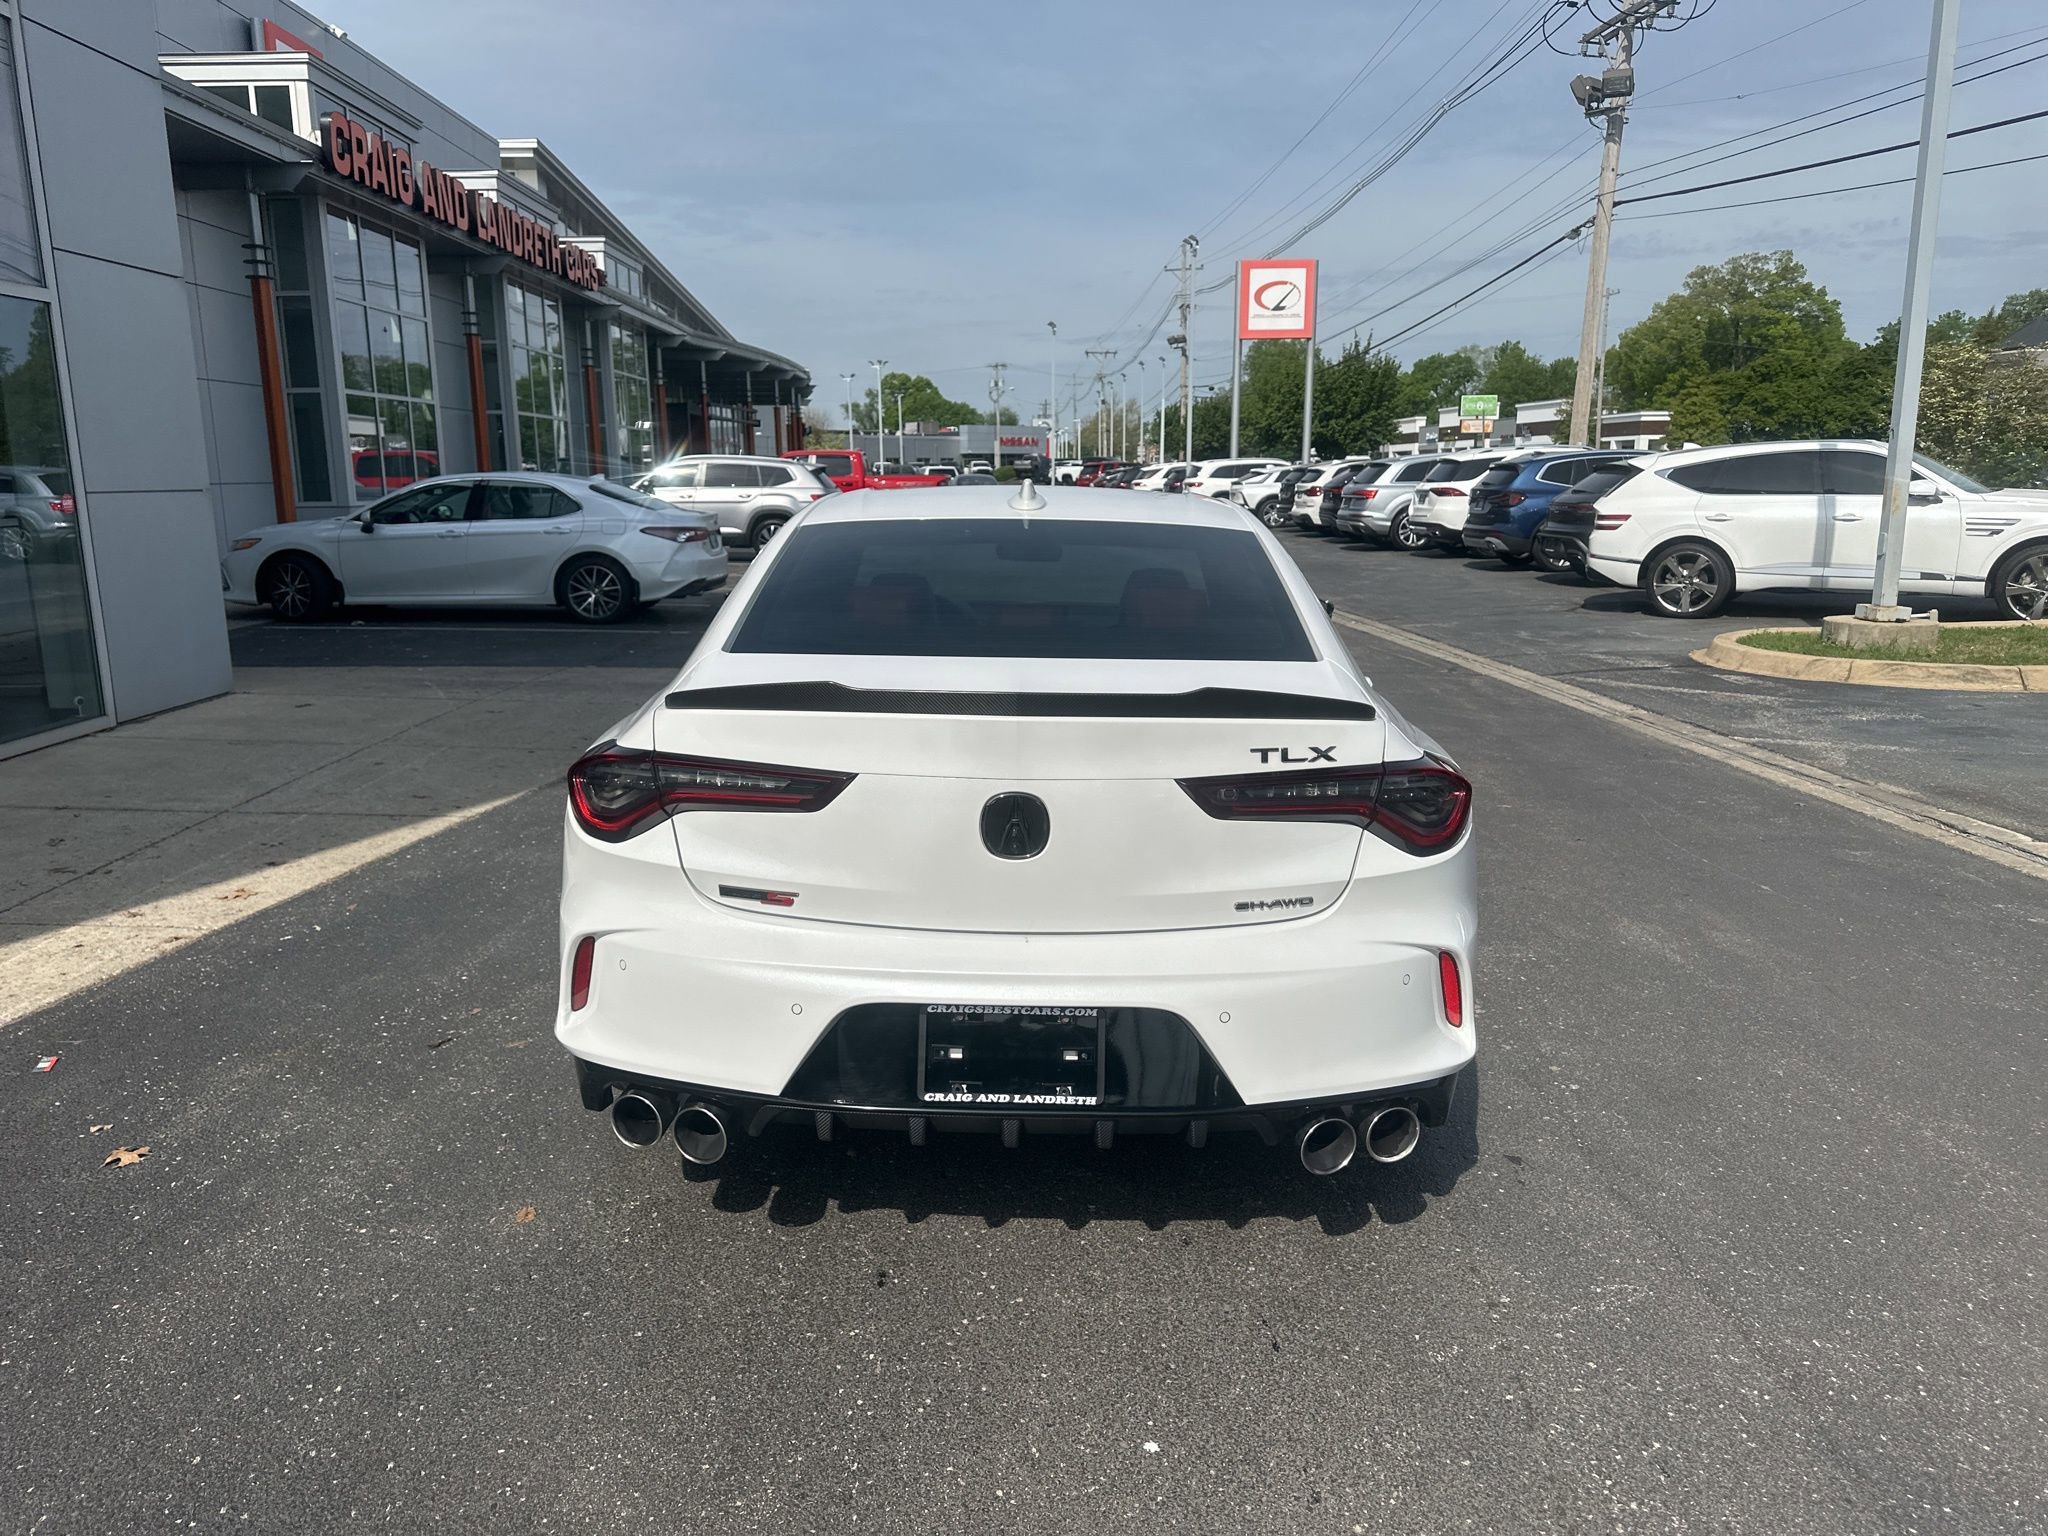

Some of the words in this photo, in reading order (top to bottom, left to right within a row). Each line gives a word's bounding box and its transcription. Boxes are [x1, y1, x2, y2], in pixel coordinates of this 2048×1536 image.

[321, 112, 414, 206] CRAIG
[420, 160, 469, 232] AND
[475, 191, 561, 275] LANDRETH
[565, 242, 600, 291] CARS
[1000, 436, 1039, 446] NISSAN
[1250, 746, 1338, 763] TLX
[927, 1004, 1098, 1017] CRAIGSBESTCARS.COM
[924, 1093, 973, 1102] CRAIG
[976, 1094, 1010, 1103] AND
[1013, 1094, 1097, 1105] LANDRETH
